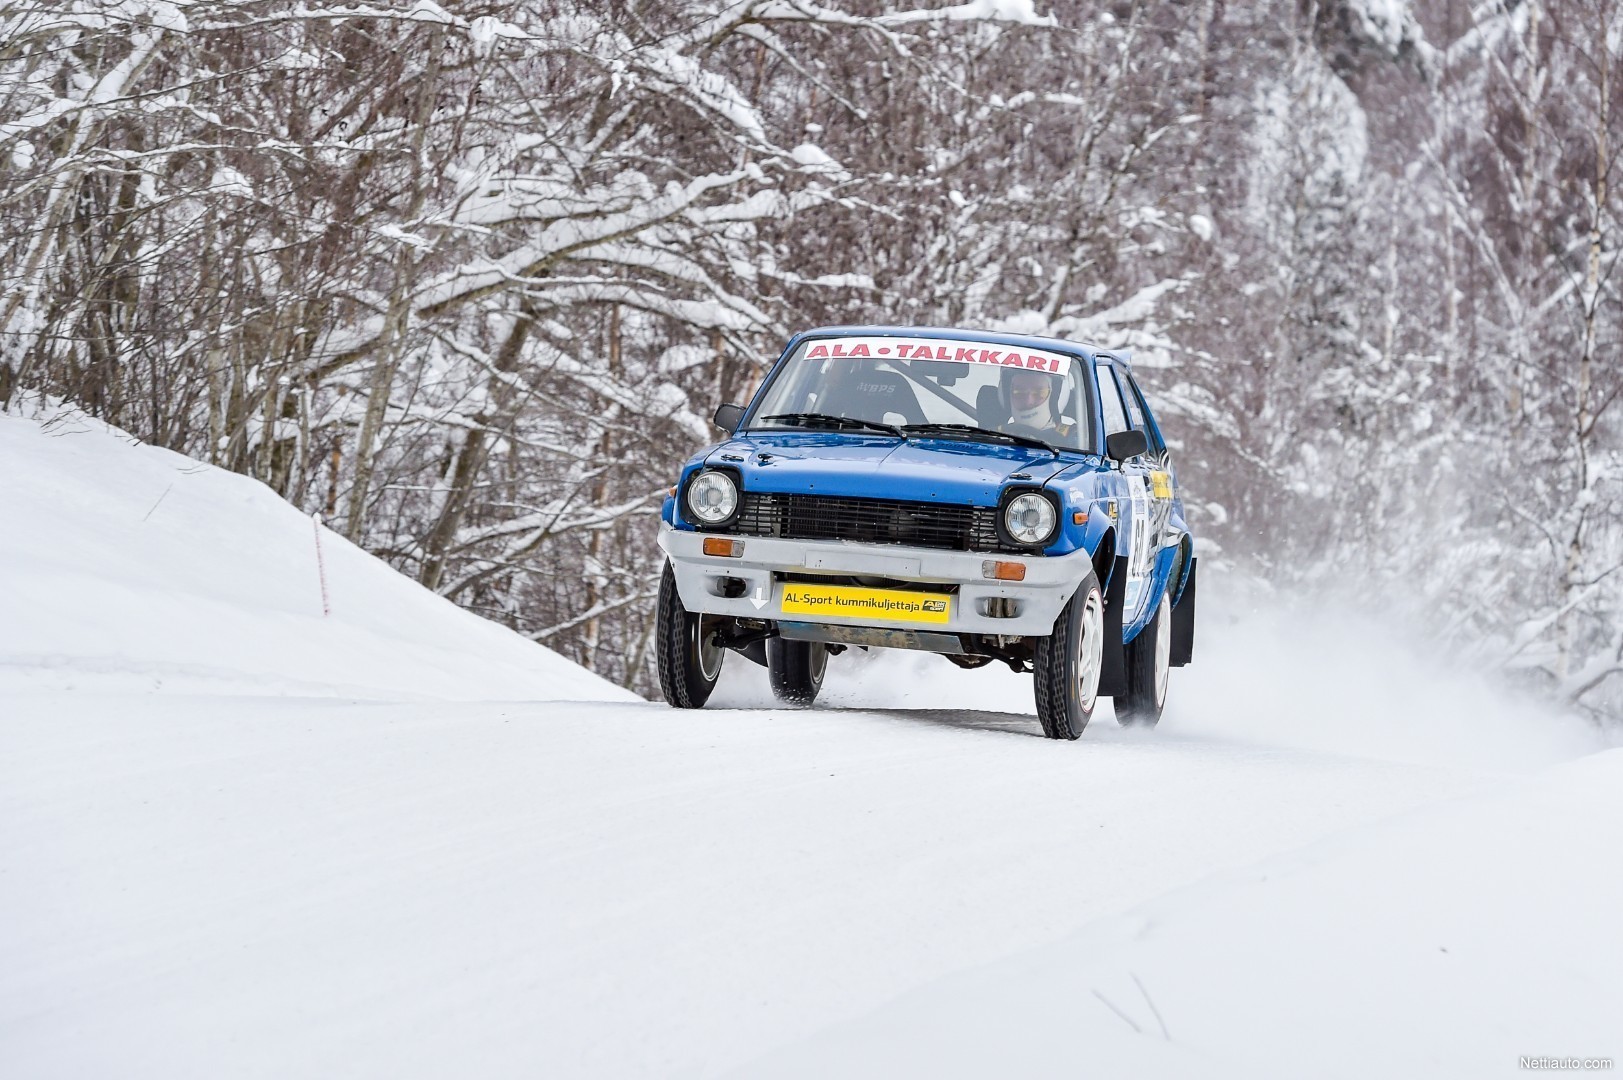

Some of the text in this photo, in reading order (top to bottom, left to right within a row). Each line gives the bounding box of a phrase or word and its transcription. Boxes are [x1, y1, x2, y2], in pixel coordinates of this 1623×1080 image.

[806, 343, 1060, 373] ALA TALKKARI
[785, 593, 832, 606] AL-Sport
[835, 596, 920, 612] kummikuljettaja
